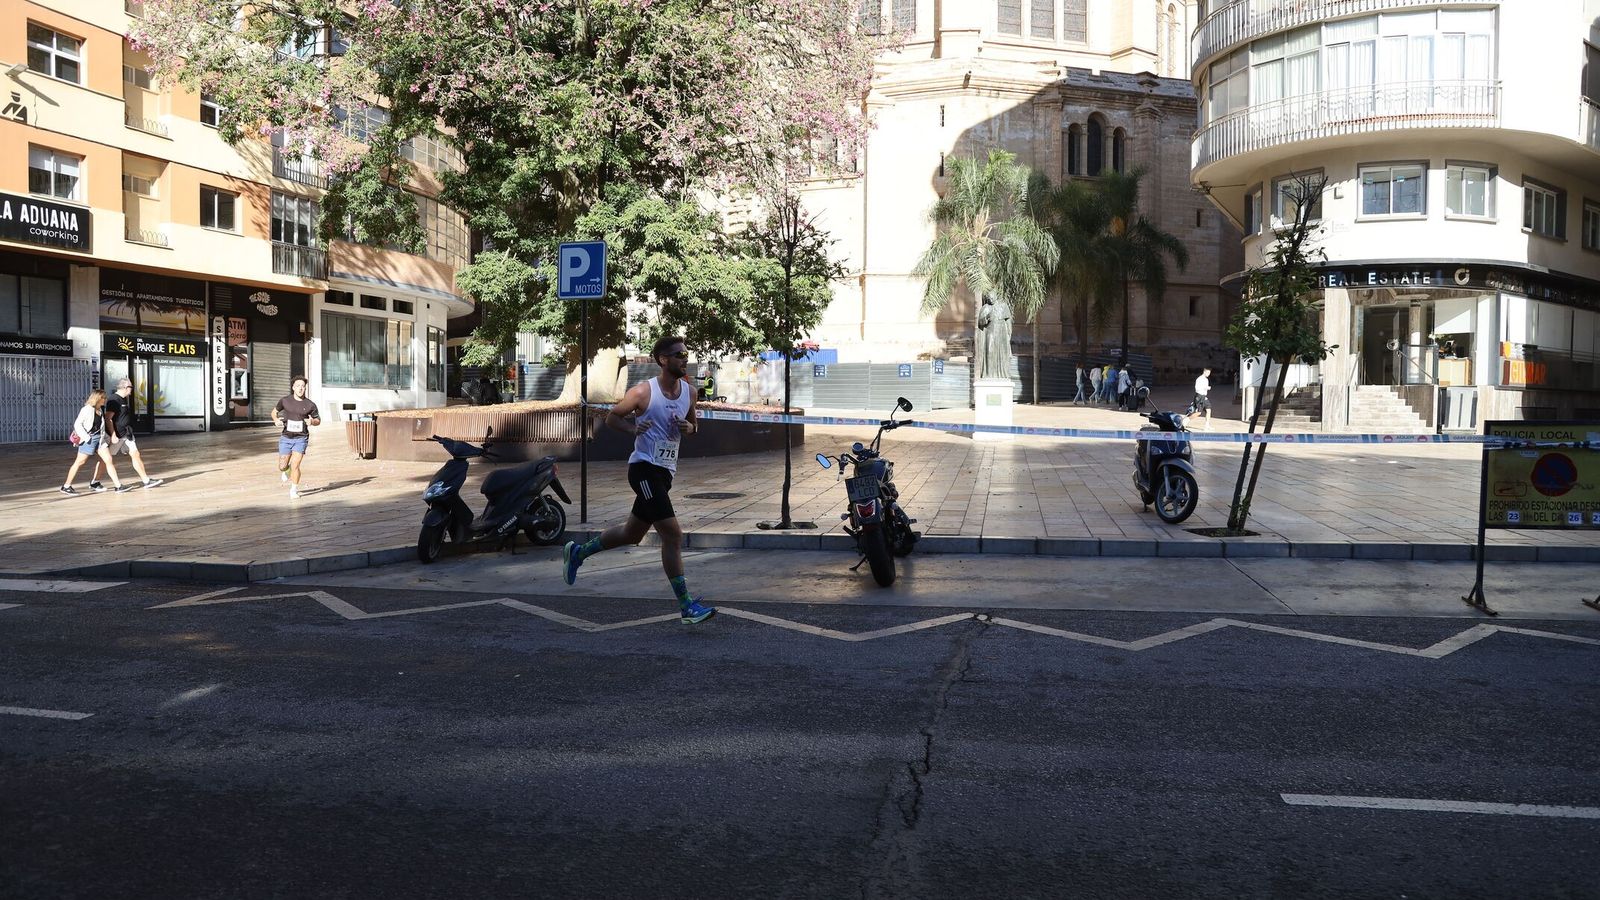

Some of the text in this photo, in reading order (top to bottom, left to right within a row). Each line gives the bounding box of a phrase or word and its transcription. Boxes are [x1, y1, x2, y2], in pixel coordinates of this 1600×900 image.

[0, 200, 79, 232] A ADUANA
[29, 227, 79, 243] coworking
[561, 247, 591, 293] P
[1318, 271, 1431, 288] REAL ESTATE
[575, 284, 602, 294] MOTOS
[228, 320, 246, 330] ATM
[0, 341, 24, 349] NAMOS
[35, 343, 72, 351] PATRIMONIO
[136, 342, 196, 355] PARQUE FLATS
[1540, 431, 1577, 440] LOCAL
[658, 448, 676, 459] 778
[858, 487, 875, 498] LCD
[1531, 502, 1578, 512] ESTACIONAR
[1488, 512, 1503, 520] LAS
[1533, 513, 1548, 522] DEL
